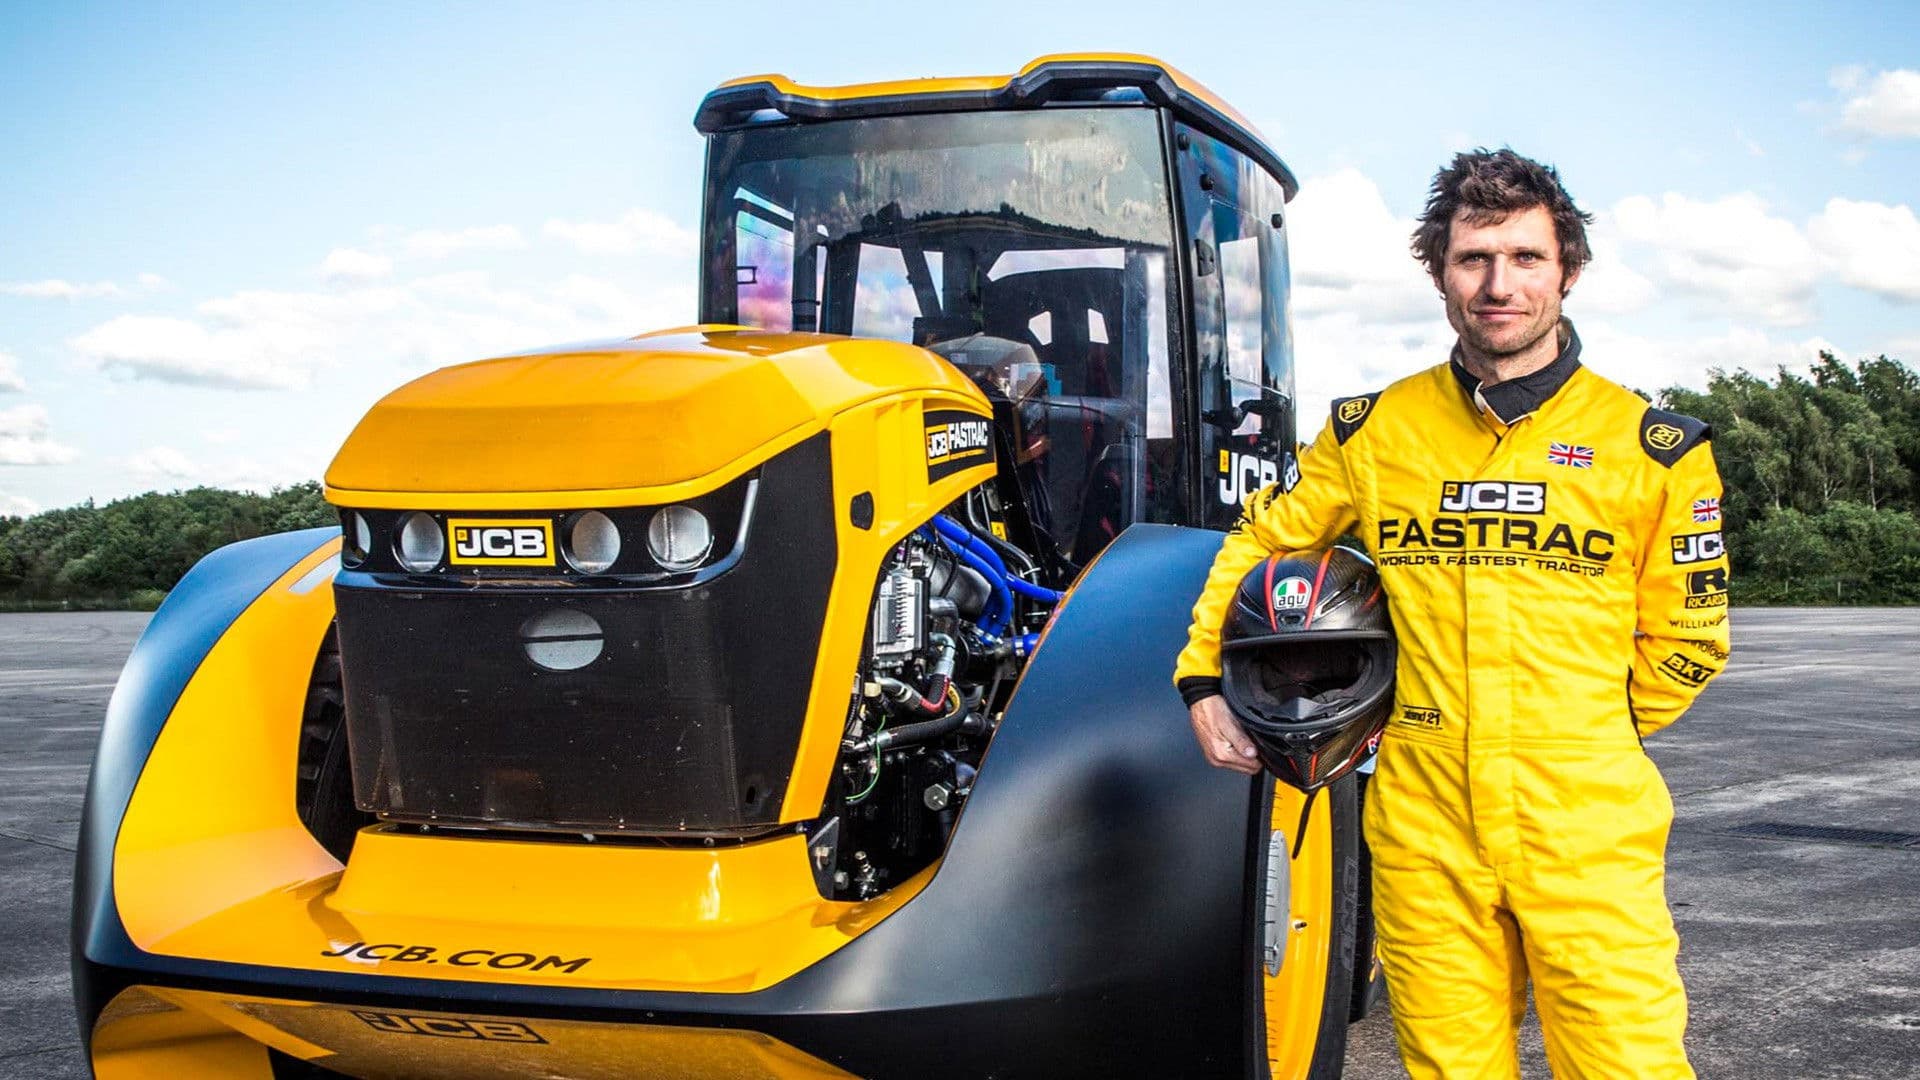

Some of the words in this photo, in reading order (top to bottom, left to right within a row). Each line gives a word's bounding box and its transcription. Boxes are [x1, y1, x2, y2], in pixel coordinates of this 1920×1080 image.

[928, 432, 947, 457] JCB
[948, 421, 988, 449] FASTRAC
[1442, 483, 1545, 512] JCB
[457, 528, 546, 557] JCB
[1378, 517, 1614, 562] FASTRAC
[1674, 533, 1724, 562] JC
[1379, 555, 1440, 566] WORLD'S
[1446, 555, 1529, 567] FASTEST
[1535, 559, 1606, 578] TRACTOR
[1687, 593, 1727, 609] RICARD
[1666, 653, 1713, 682] BKT
[321, 941, 592, 974] JCB.COM
[372, 1012, 532, 1043] JCB
